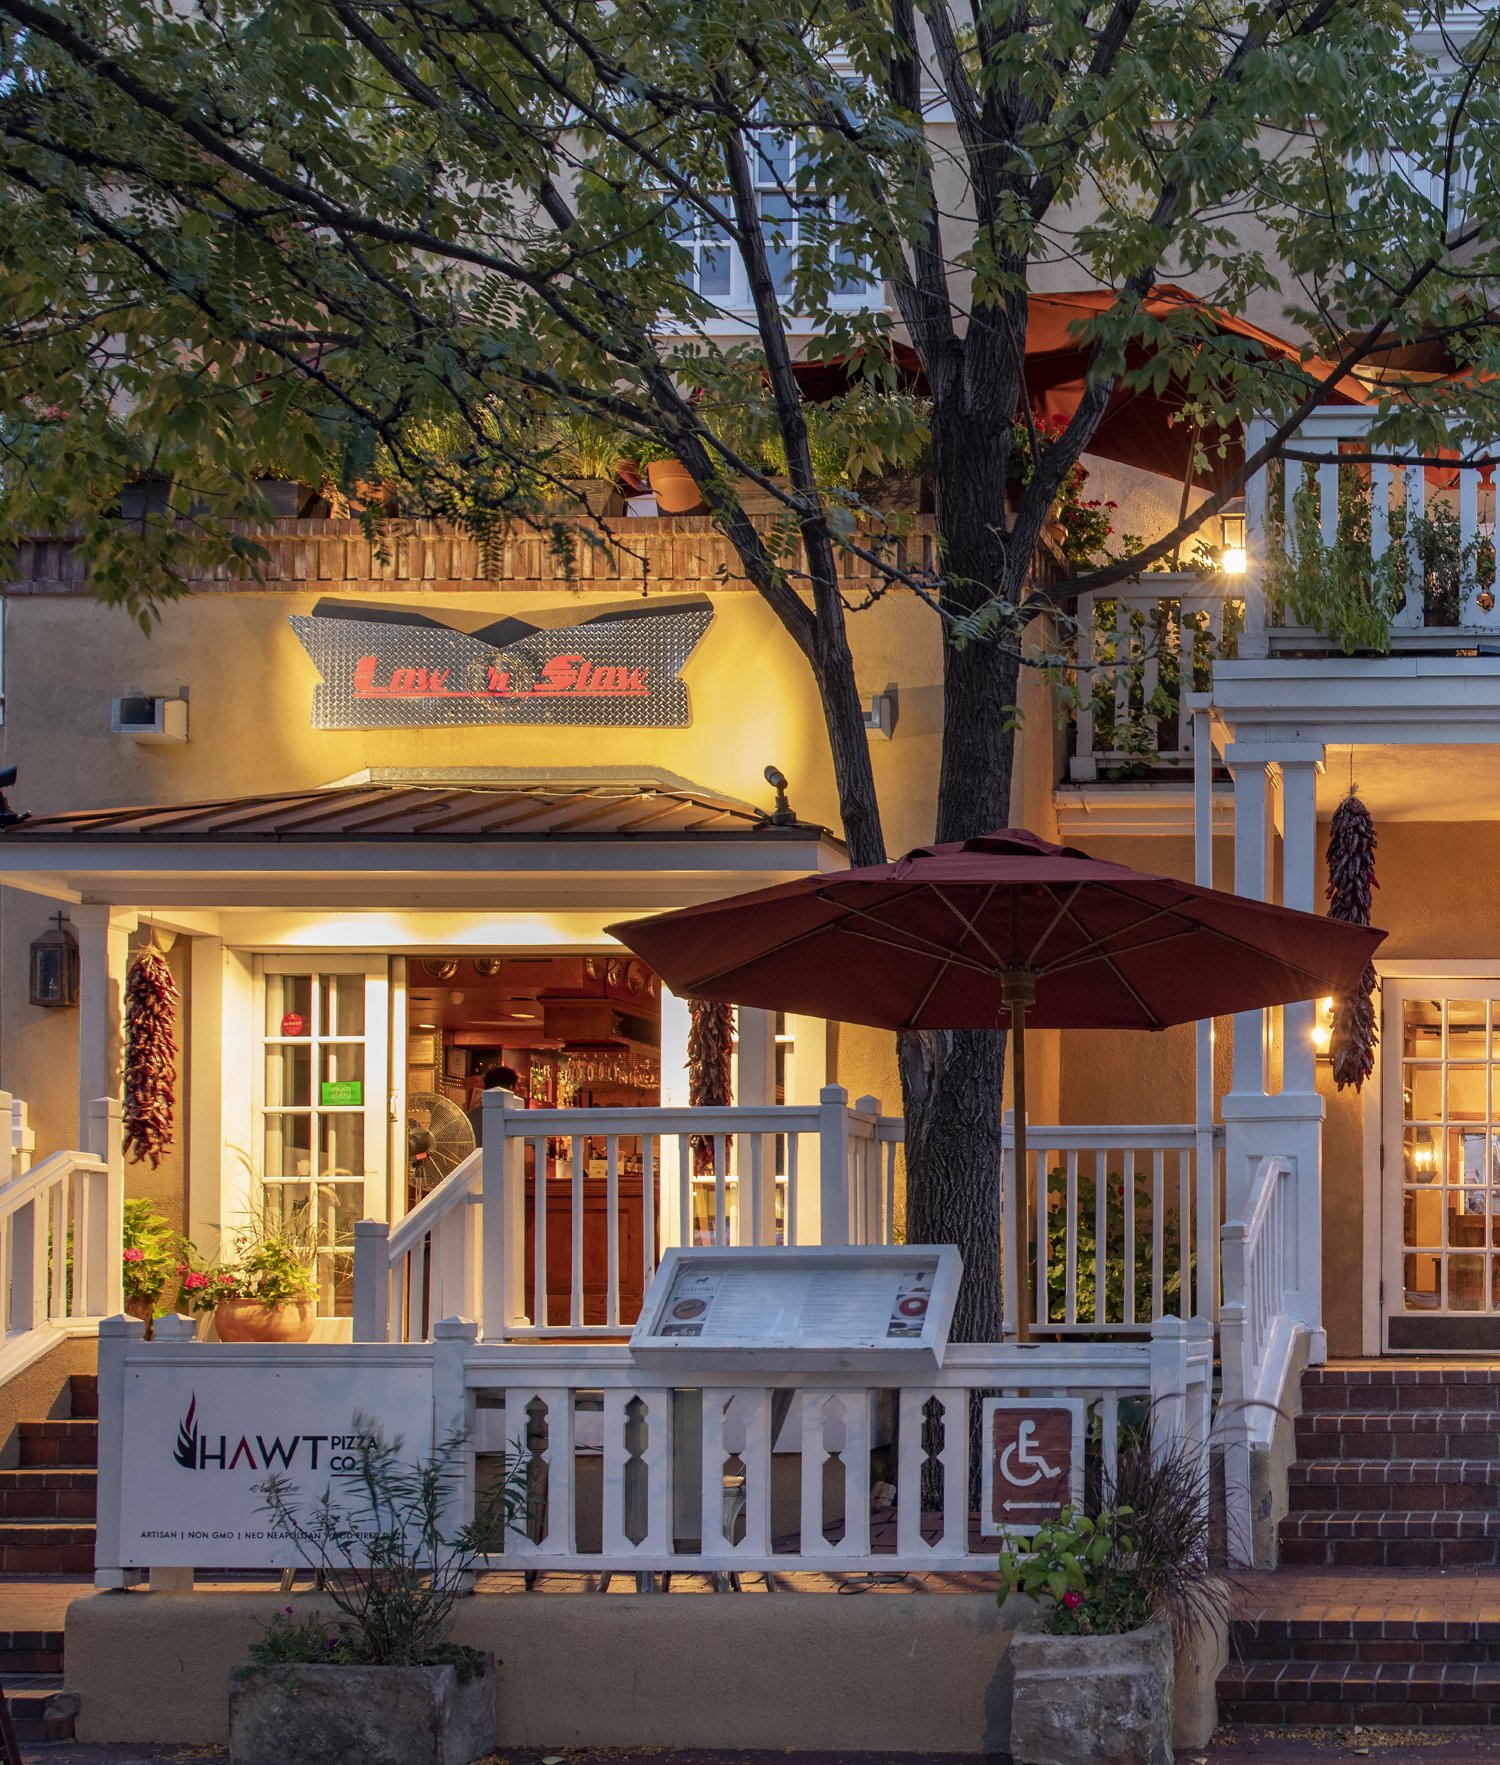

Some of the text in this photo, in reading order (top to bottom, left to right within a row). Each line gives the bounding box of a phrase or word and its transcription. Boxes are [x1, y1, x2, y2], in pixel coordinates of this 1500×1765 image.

[353, 656, 450, 692] Low
[533, 655, 651, 691] Slow
[200, 1435, 378, 1470] HAWT PIZZA
[140, 1531, 177, 1539] ARTISAN
[188, 1531, 209, 1539] NON
[212, 1531, 234, 1539] GMO
[244, 1531, 264, 1540] NEO
[267, 1531, 321, 1540] NEAPOLITAN
